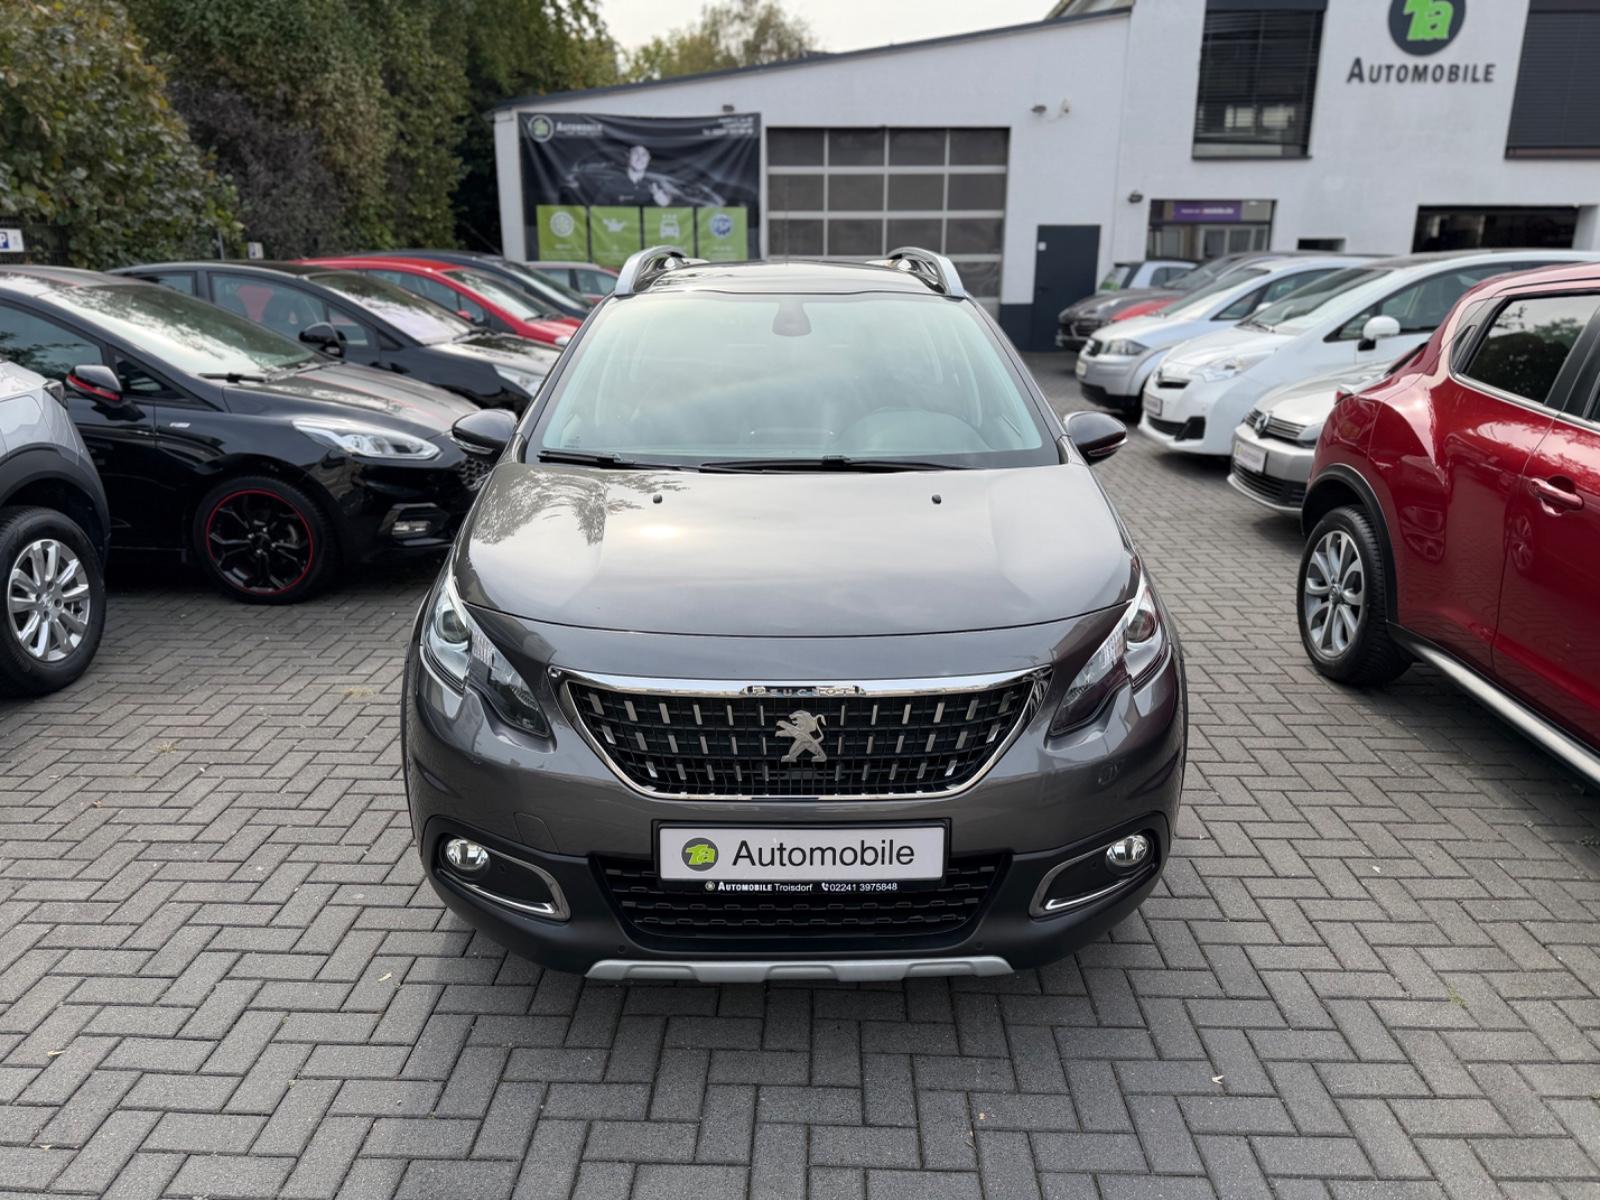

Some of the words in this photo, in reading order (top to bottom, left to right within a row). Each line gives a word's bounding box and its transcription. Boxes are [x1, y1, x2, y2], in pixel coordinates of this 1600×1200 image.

[1347, 57, 1495, 83] AUTOMOBILE
[731, 839, 915, 867] Automobile
[718, 881, 772, 891] AUTOMOBILE
[775, 883, 813, 892] Troisdorf
[830, 884, 856, 892] 02241
[859, 883, 898, 891] 3975848
